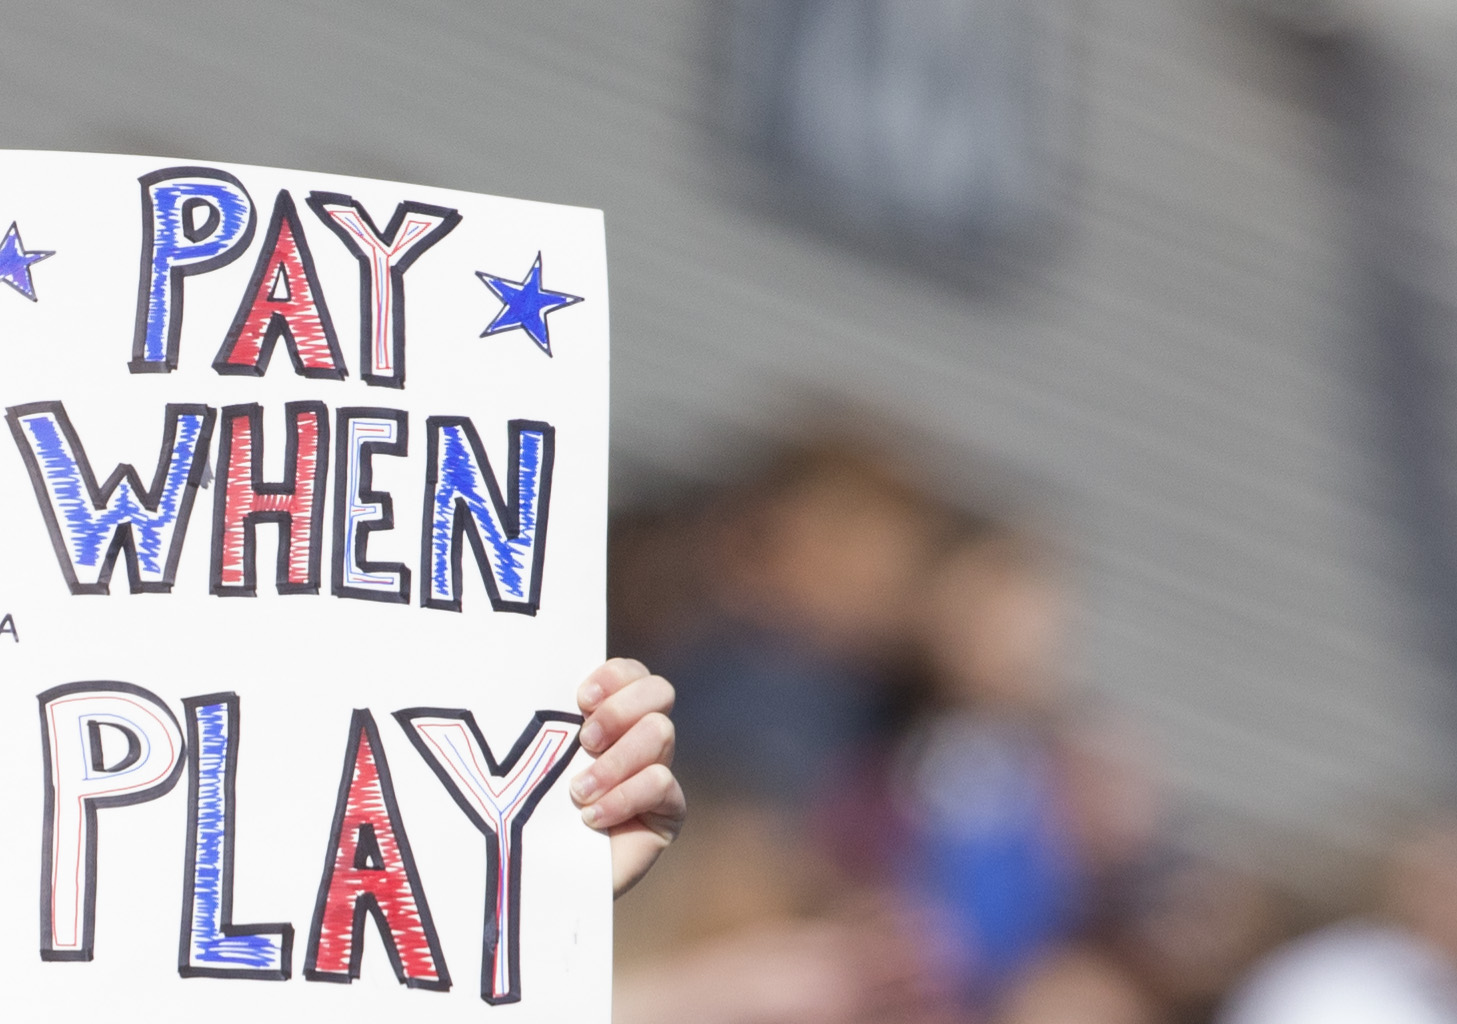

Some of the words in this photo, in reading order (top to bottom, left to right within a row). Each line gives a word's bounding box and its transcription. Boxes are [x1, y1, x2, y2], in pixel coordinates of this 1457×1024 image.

[128, 166, 462, 389] PAY
[5, 400, 555, 615] WHEN
[37, 681, 584, 1006] PLAY
